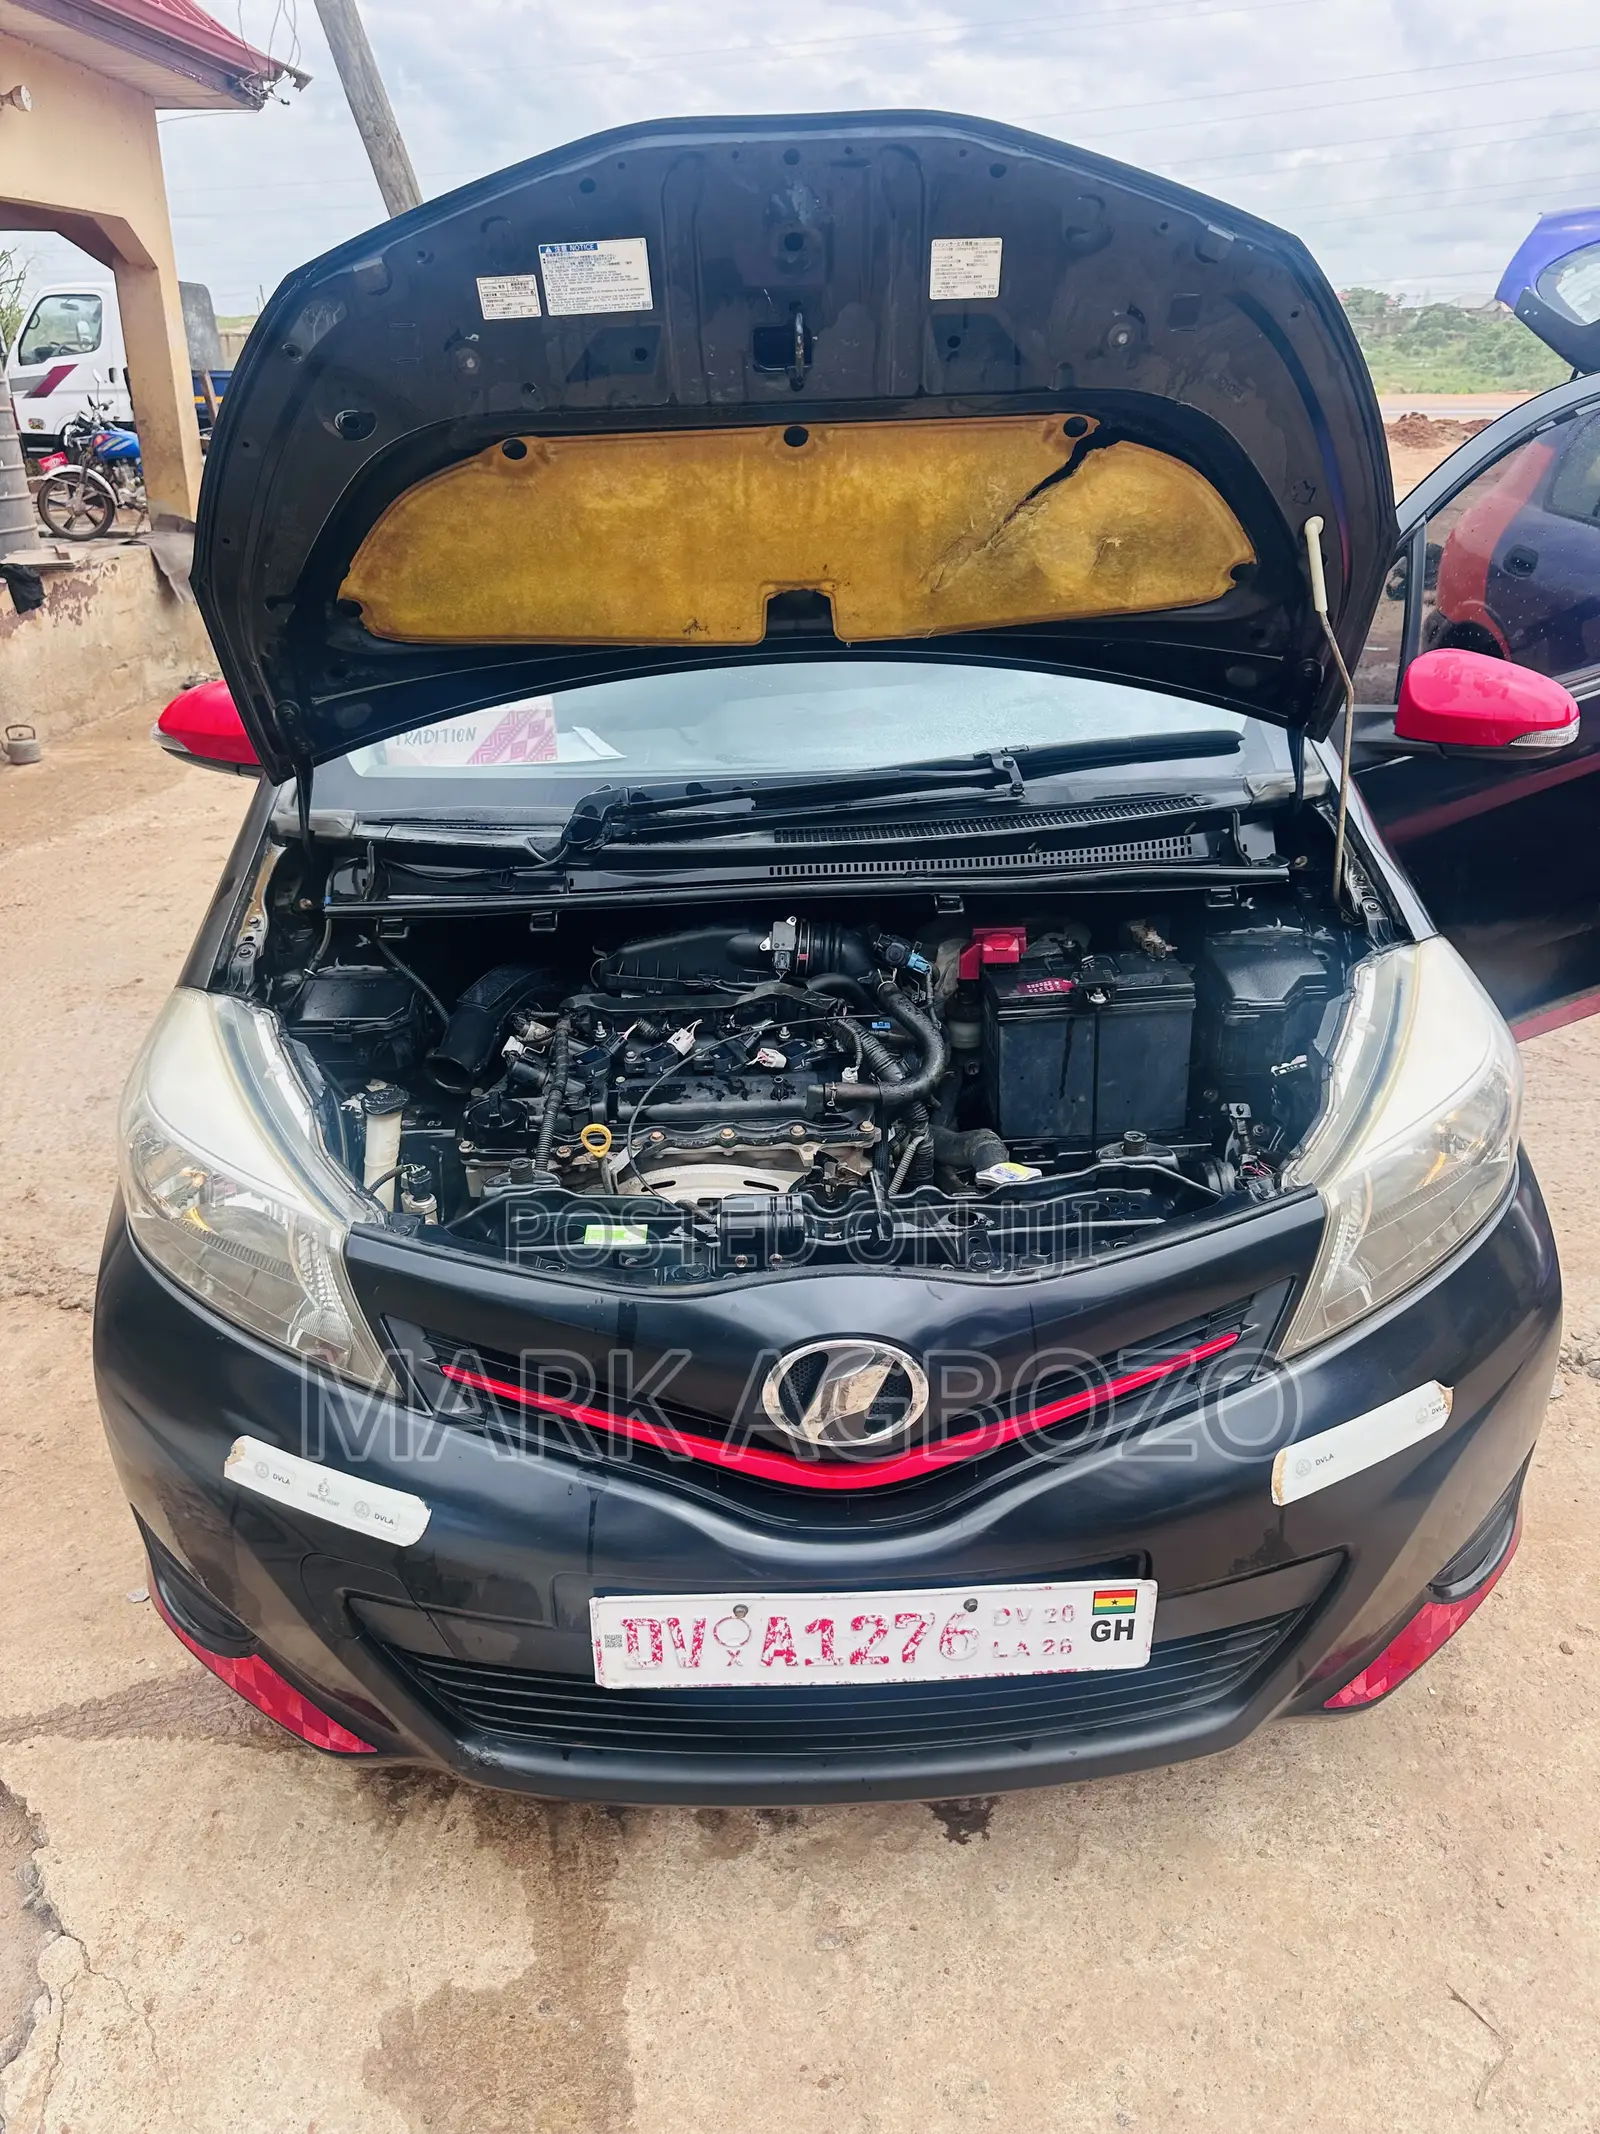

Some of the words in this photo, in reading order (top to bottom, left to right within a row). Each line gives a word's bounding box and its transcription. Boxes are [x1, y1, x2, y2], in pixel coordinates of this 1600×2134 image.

[569, 243, 595, 251] NOTICE
[1431, 1403, 1447, 1415] DVLA
[1315, 1453, 1335, 1466] DVLA
[272, 1472, 291, 1486] DVLA
[374, 1512, 394, 1526] DVLA
[991, 1605, 1033, 1626] DV
[1090, 1618, 1136, 1643] GH
[621, 1616, 707, 1670] DV
[760, 1611, 981, 1668] A1276
[991, 1640, 1031, 1659] LA
